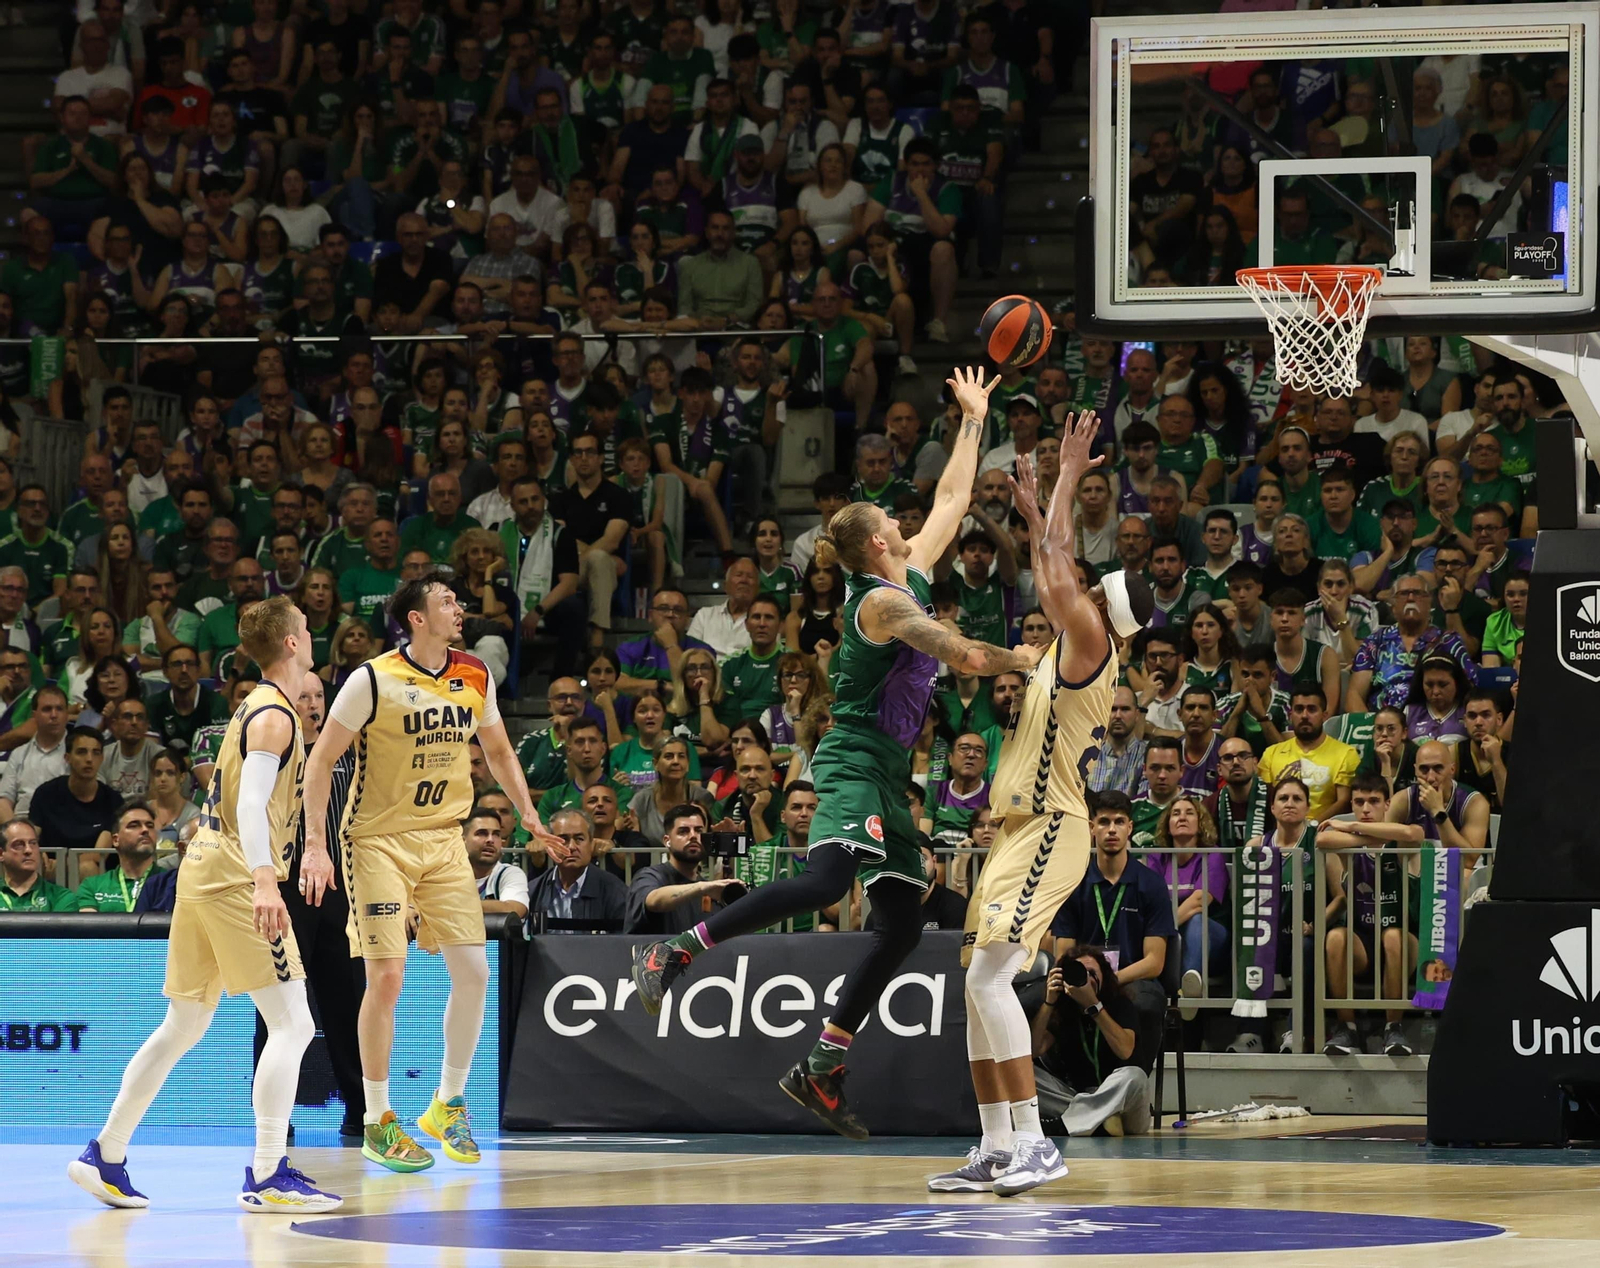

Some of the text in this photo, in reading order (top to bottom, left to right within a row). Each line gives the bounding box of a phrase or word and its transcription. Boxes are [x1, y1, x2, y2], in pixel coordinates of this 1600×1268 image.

[1297, 72, 1331, 104] adidas
[1514, 250, 1551, 259] PLAYOFF
[403, 706, 473, 735] UCAM
[415, 731, 464, 748] MURCIA
[413, 779, 448, 807] 00
[369, 903, 401, 916] ESP
